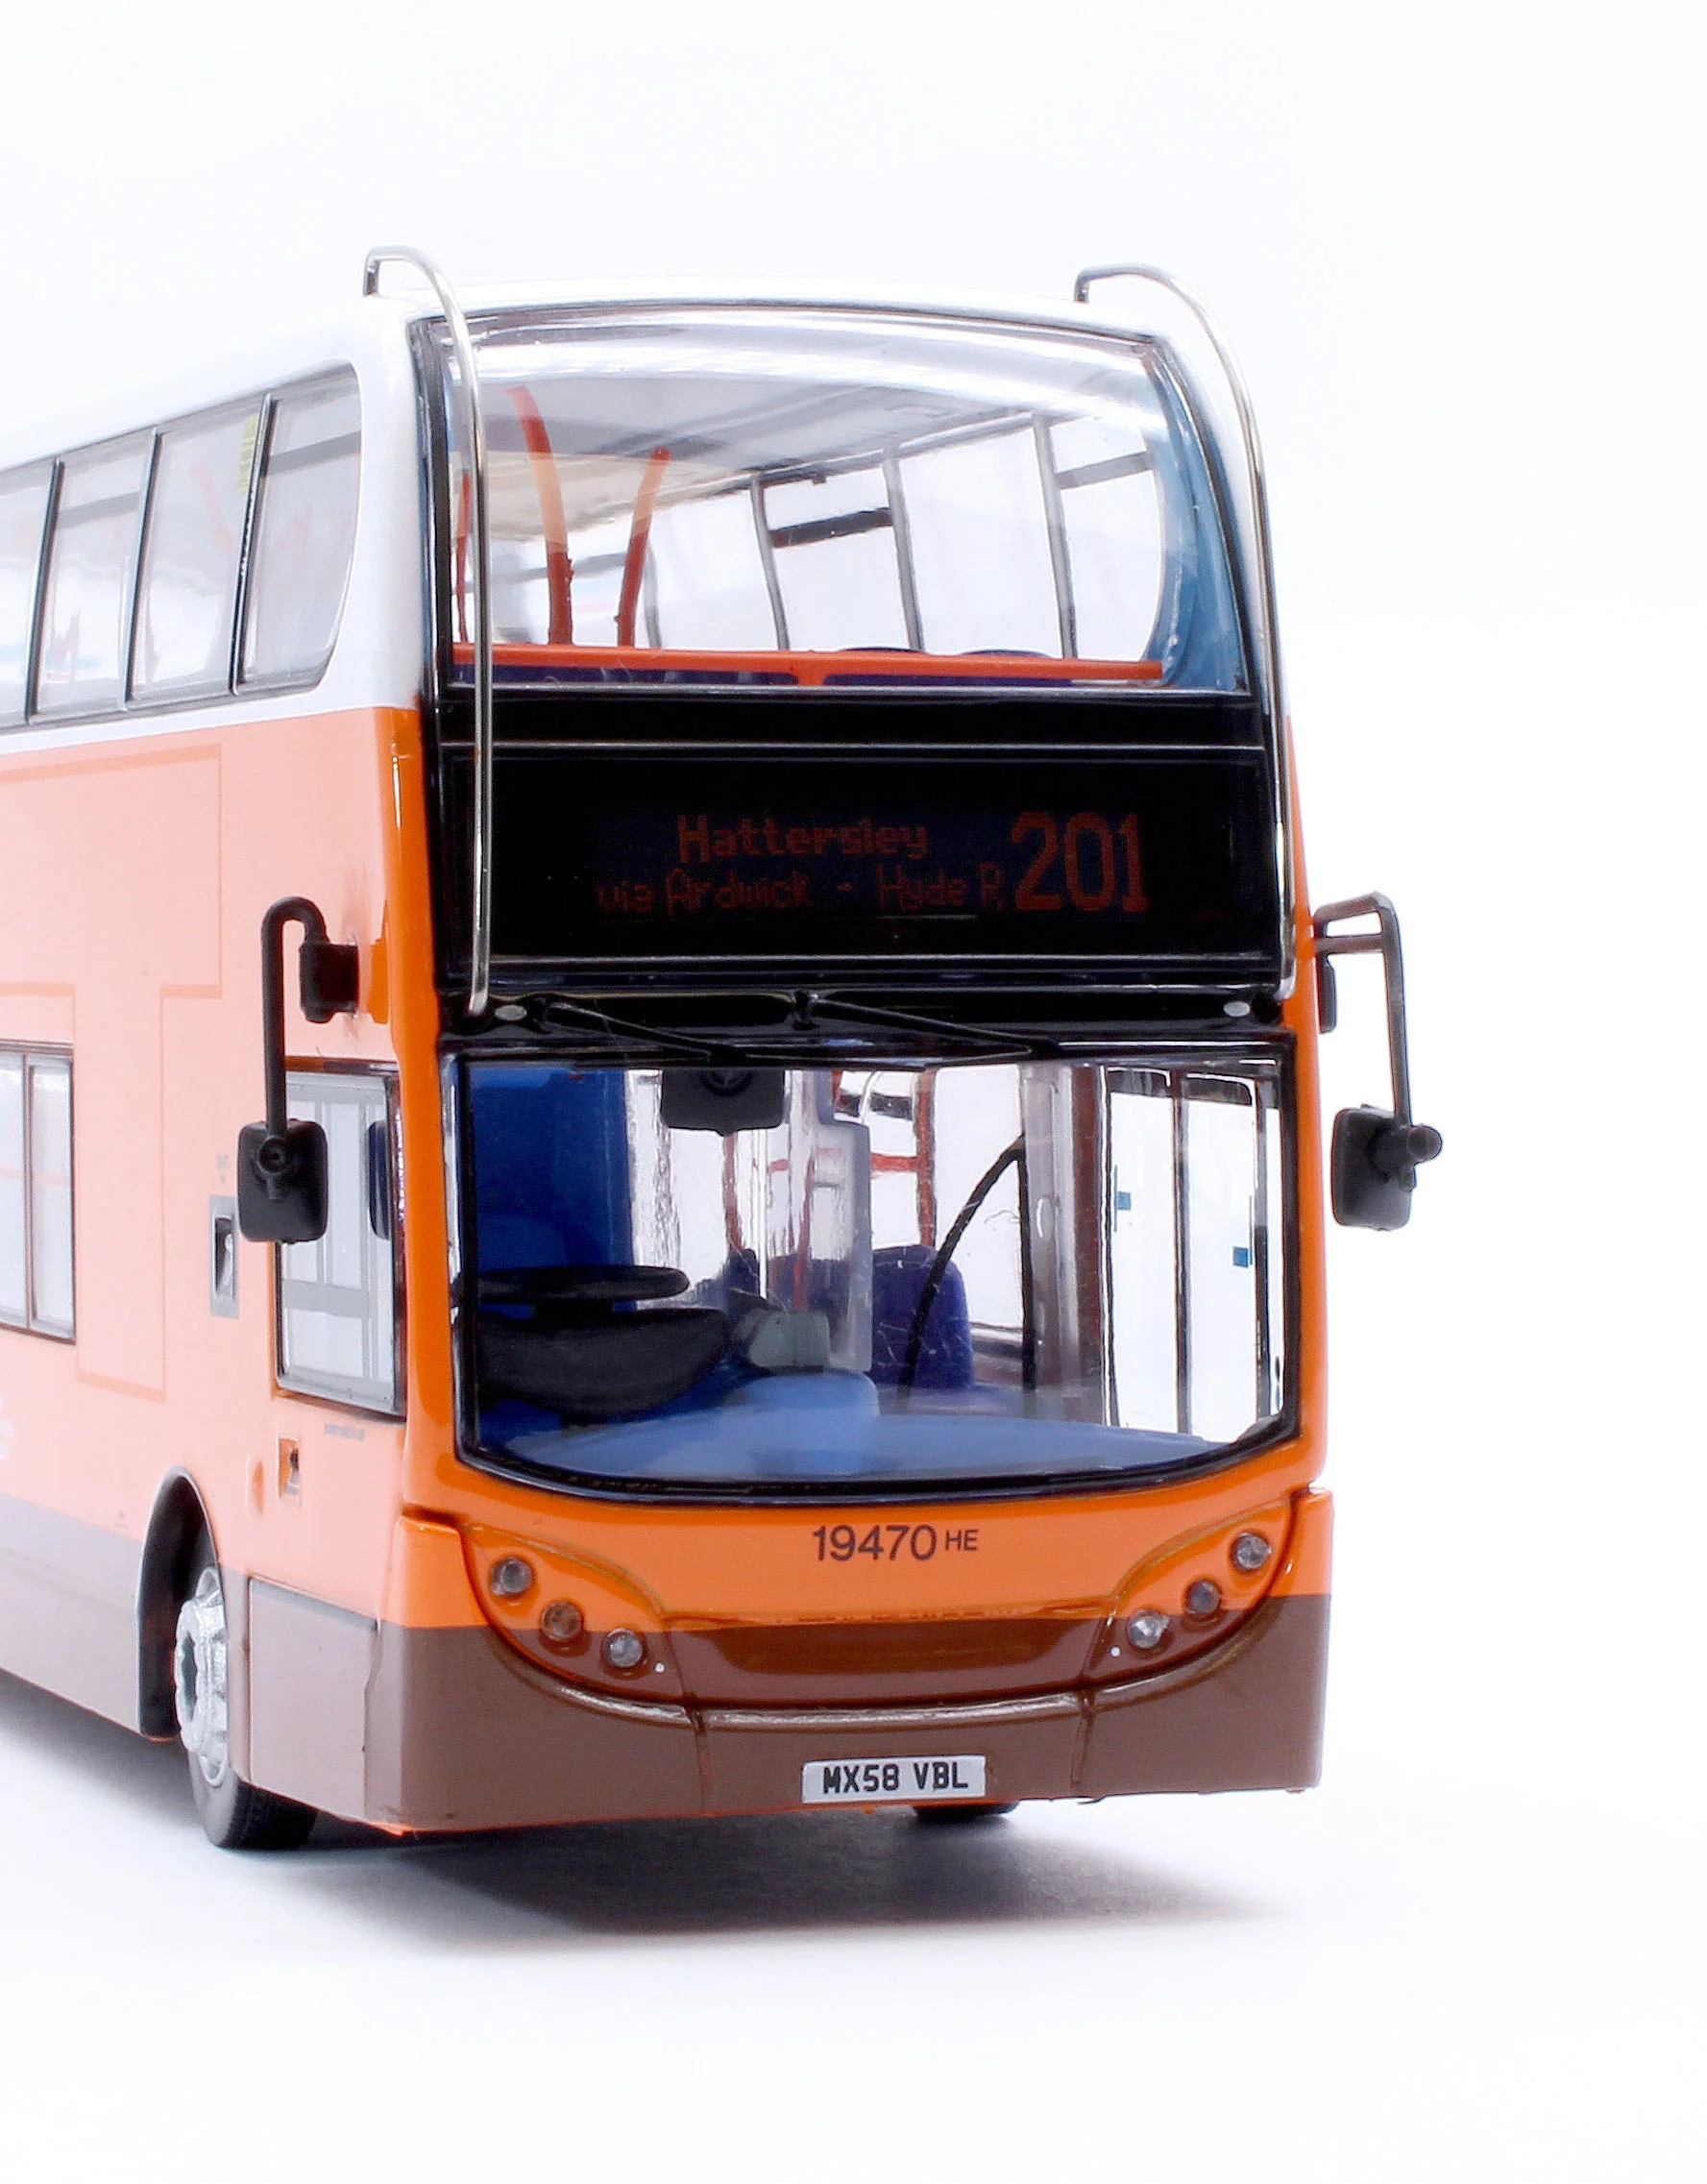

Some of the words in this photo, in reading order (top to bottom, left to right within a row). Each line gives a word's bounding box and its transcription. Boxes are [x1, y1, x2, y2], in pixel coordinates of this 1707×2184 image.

[676, 813, 929, 862] Hattersley
[1011, 811, 1149, 912] 201
[596, 880, 655, 914] via
[813, 1524, 938, 1561] 19470
[945, 1530, 979, 1552] HE
[822, 1764, 900, 1794] MX58
[914, 1761, 968, 1791] VBL
